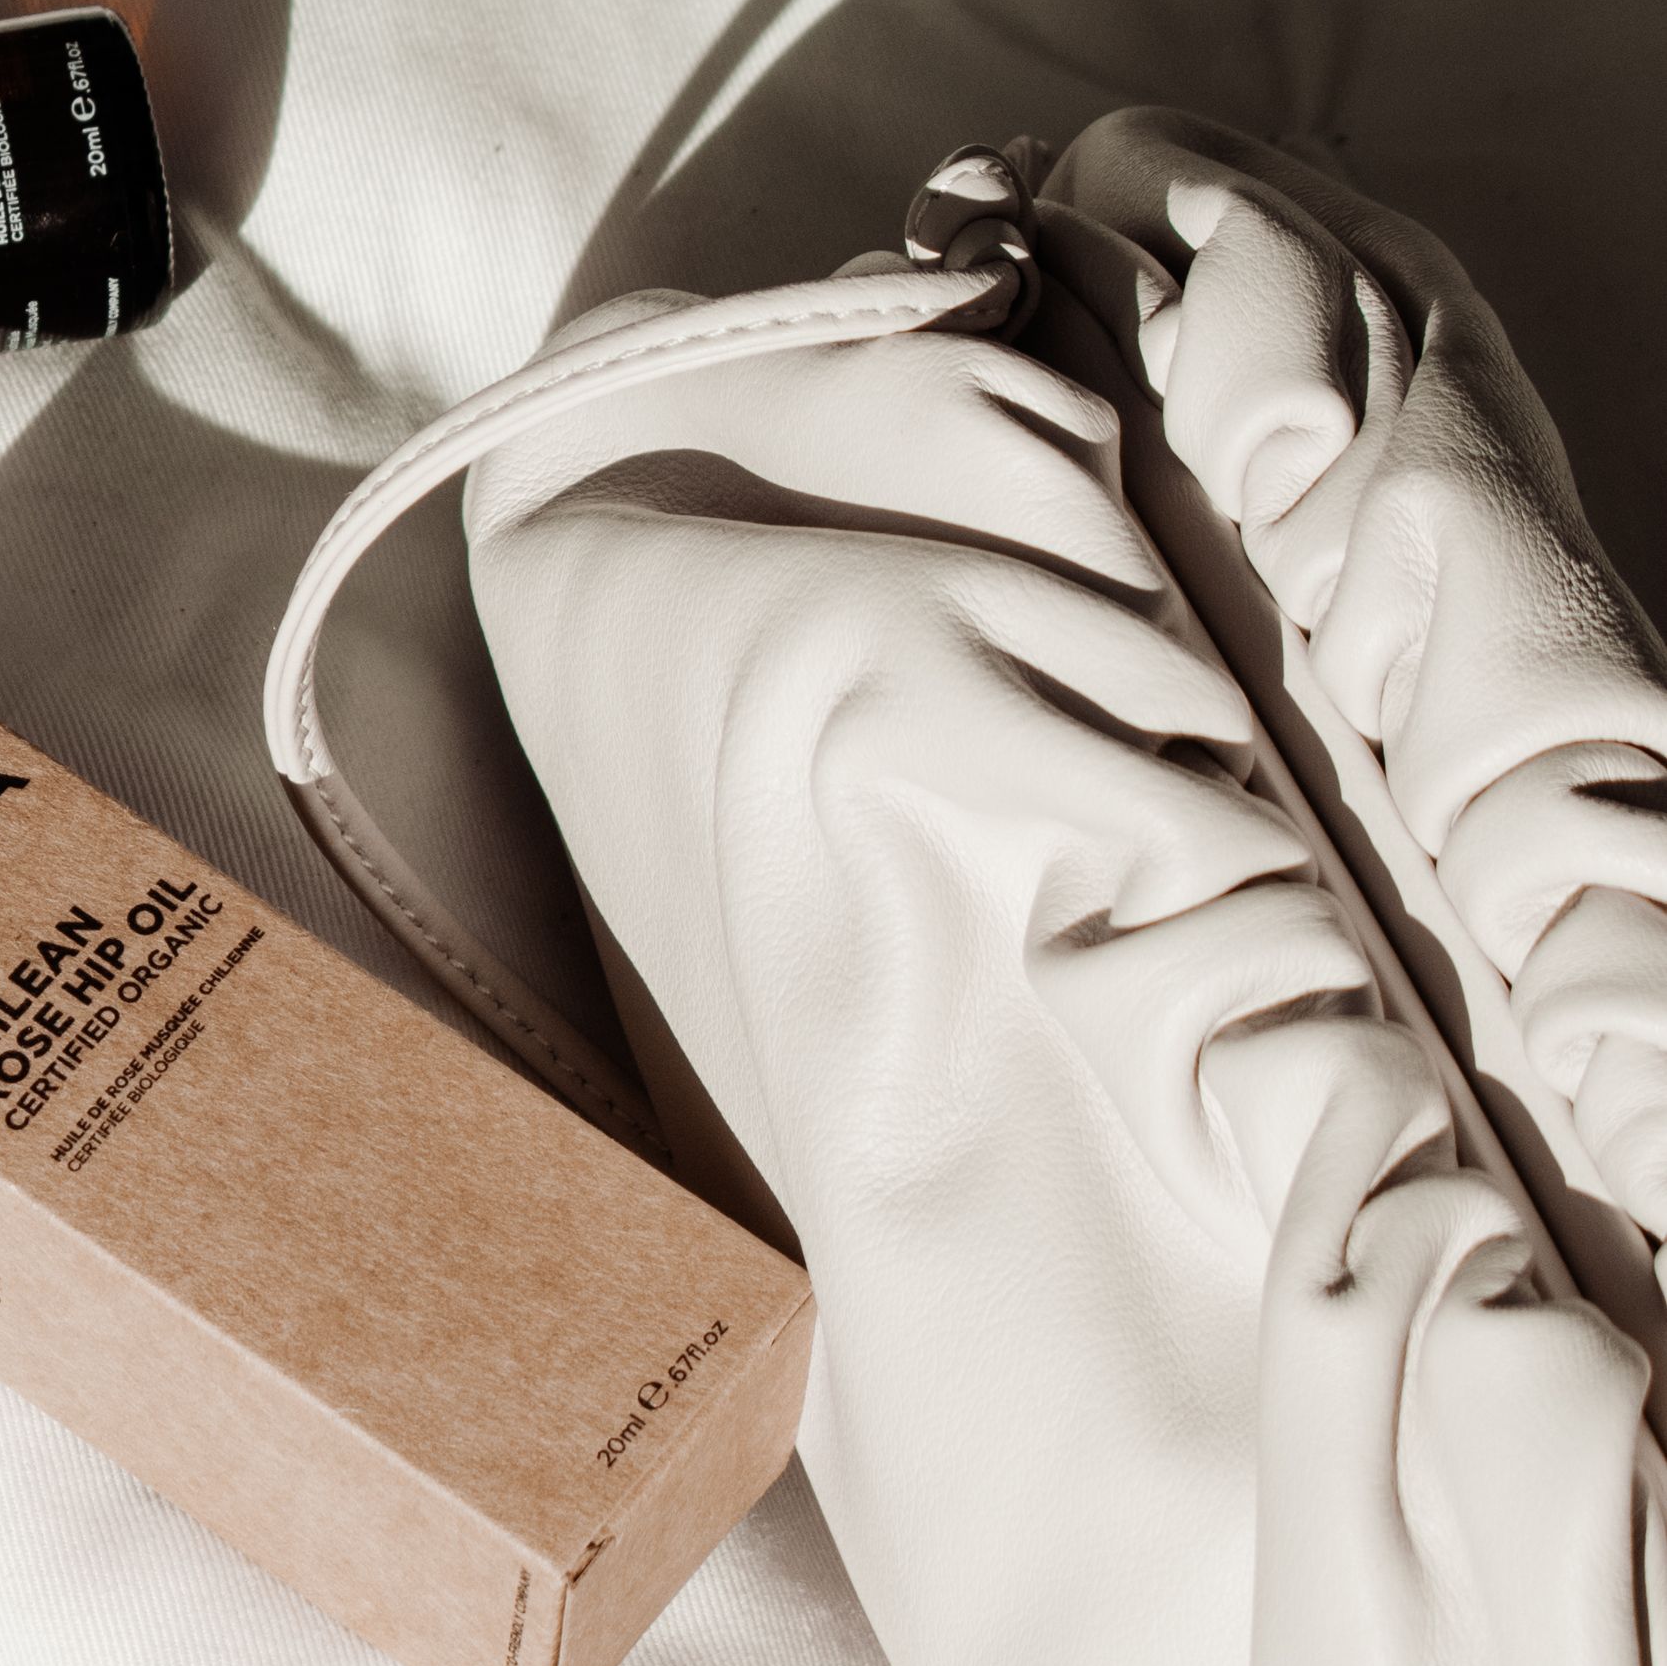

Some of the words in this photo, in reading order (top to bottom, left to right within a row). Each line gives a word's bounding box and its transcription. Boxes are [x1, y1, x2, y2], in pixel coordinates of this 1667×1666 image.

[1, 169, 24, 242] CERTIFIÉE
[82, 126, 107, 177] 20ml
[61, 937, 125, 1006] HIP
[127, 879, 198, 935] OIL
[5, 1006, 120, 1130] CERTIFIED
[117, 894, 223, 1003] ORGANIC
[50, 1118, 91, 1162] HUILE
[87, 1096, 110, 1120] DE
[105, 1058, 145, 1099] ROSE
[139, 994, 202, 1060] MUSQUÉE
[198, 925, 266, 995] CHILIENNE
[67, 1102, 132, 1172] CERTIFIÉE
[127, 1019, 205, 1104] BIOLOGIQUE
[597, 1413, 646, 1468] 20ml
